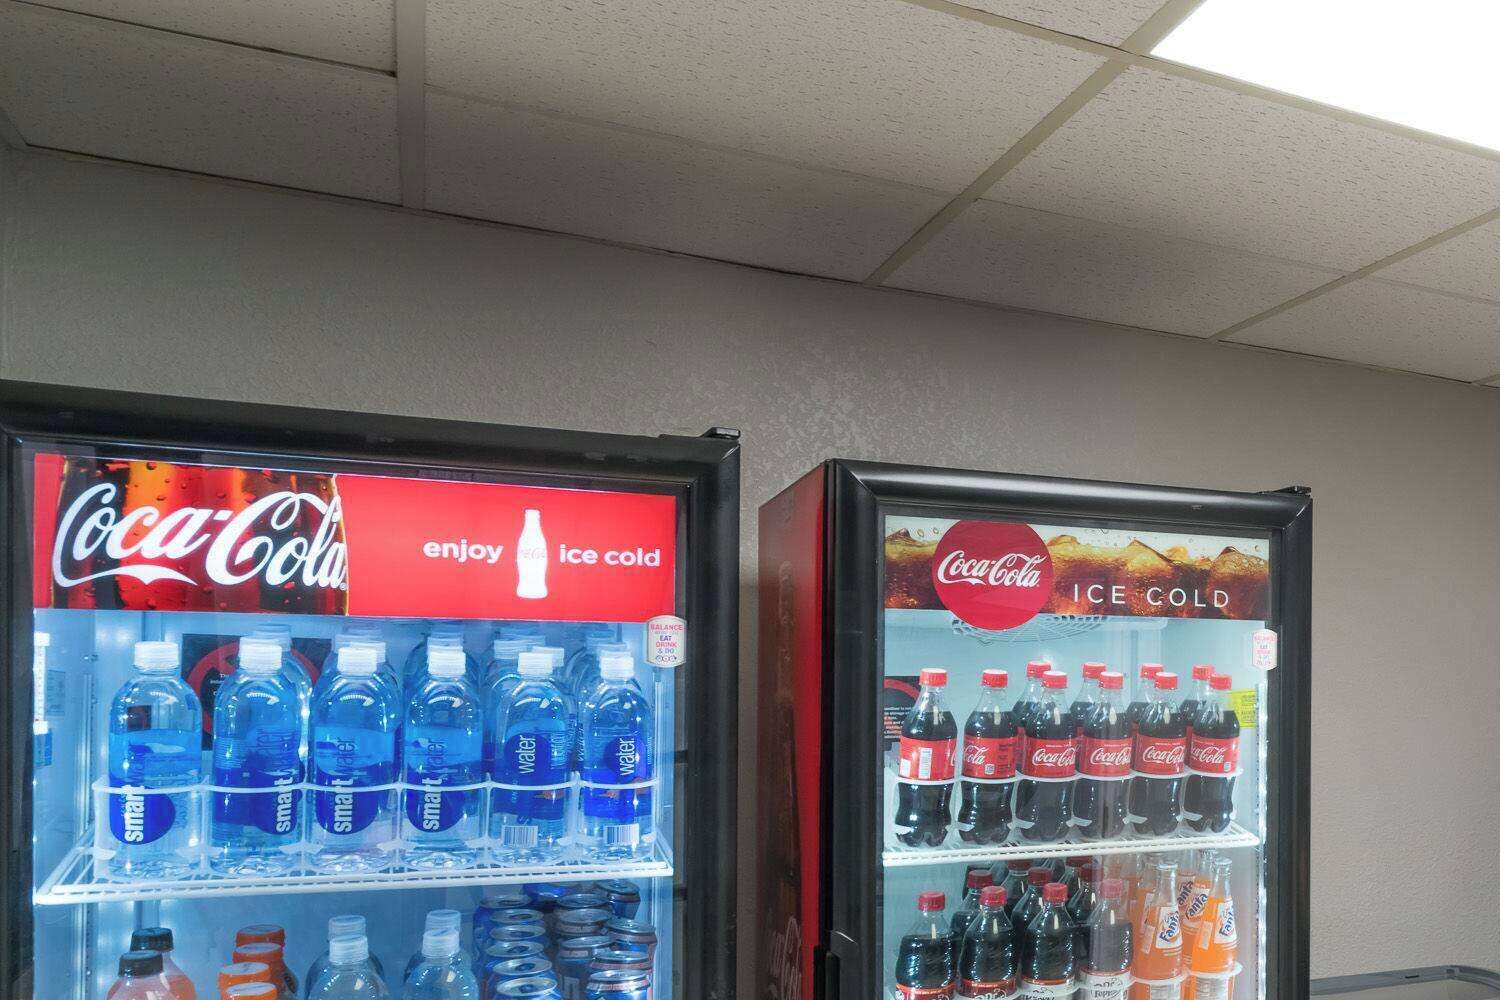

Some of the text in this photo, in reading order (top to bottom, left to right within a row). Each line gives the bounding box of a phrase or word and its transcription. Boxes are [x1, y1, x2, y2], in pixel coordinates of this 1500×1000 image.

[52, 482, 347, 590] Coca-Cola
[422, 538, 504, 564] enjoy
[559, 544, 599, 564] ice
[603, 548, 661, 567] cold
[937, 550, 1048, 588] Coca-Cola
[1073, 584, 1230, 609] ICE COLD
[514, 734, 537, 774] water
[619, 736, 635, 777] water
